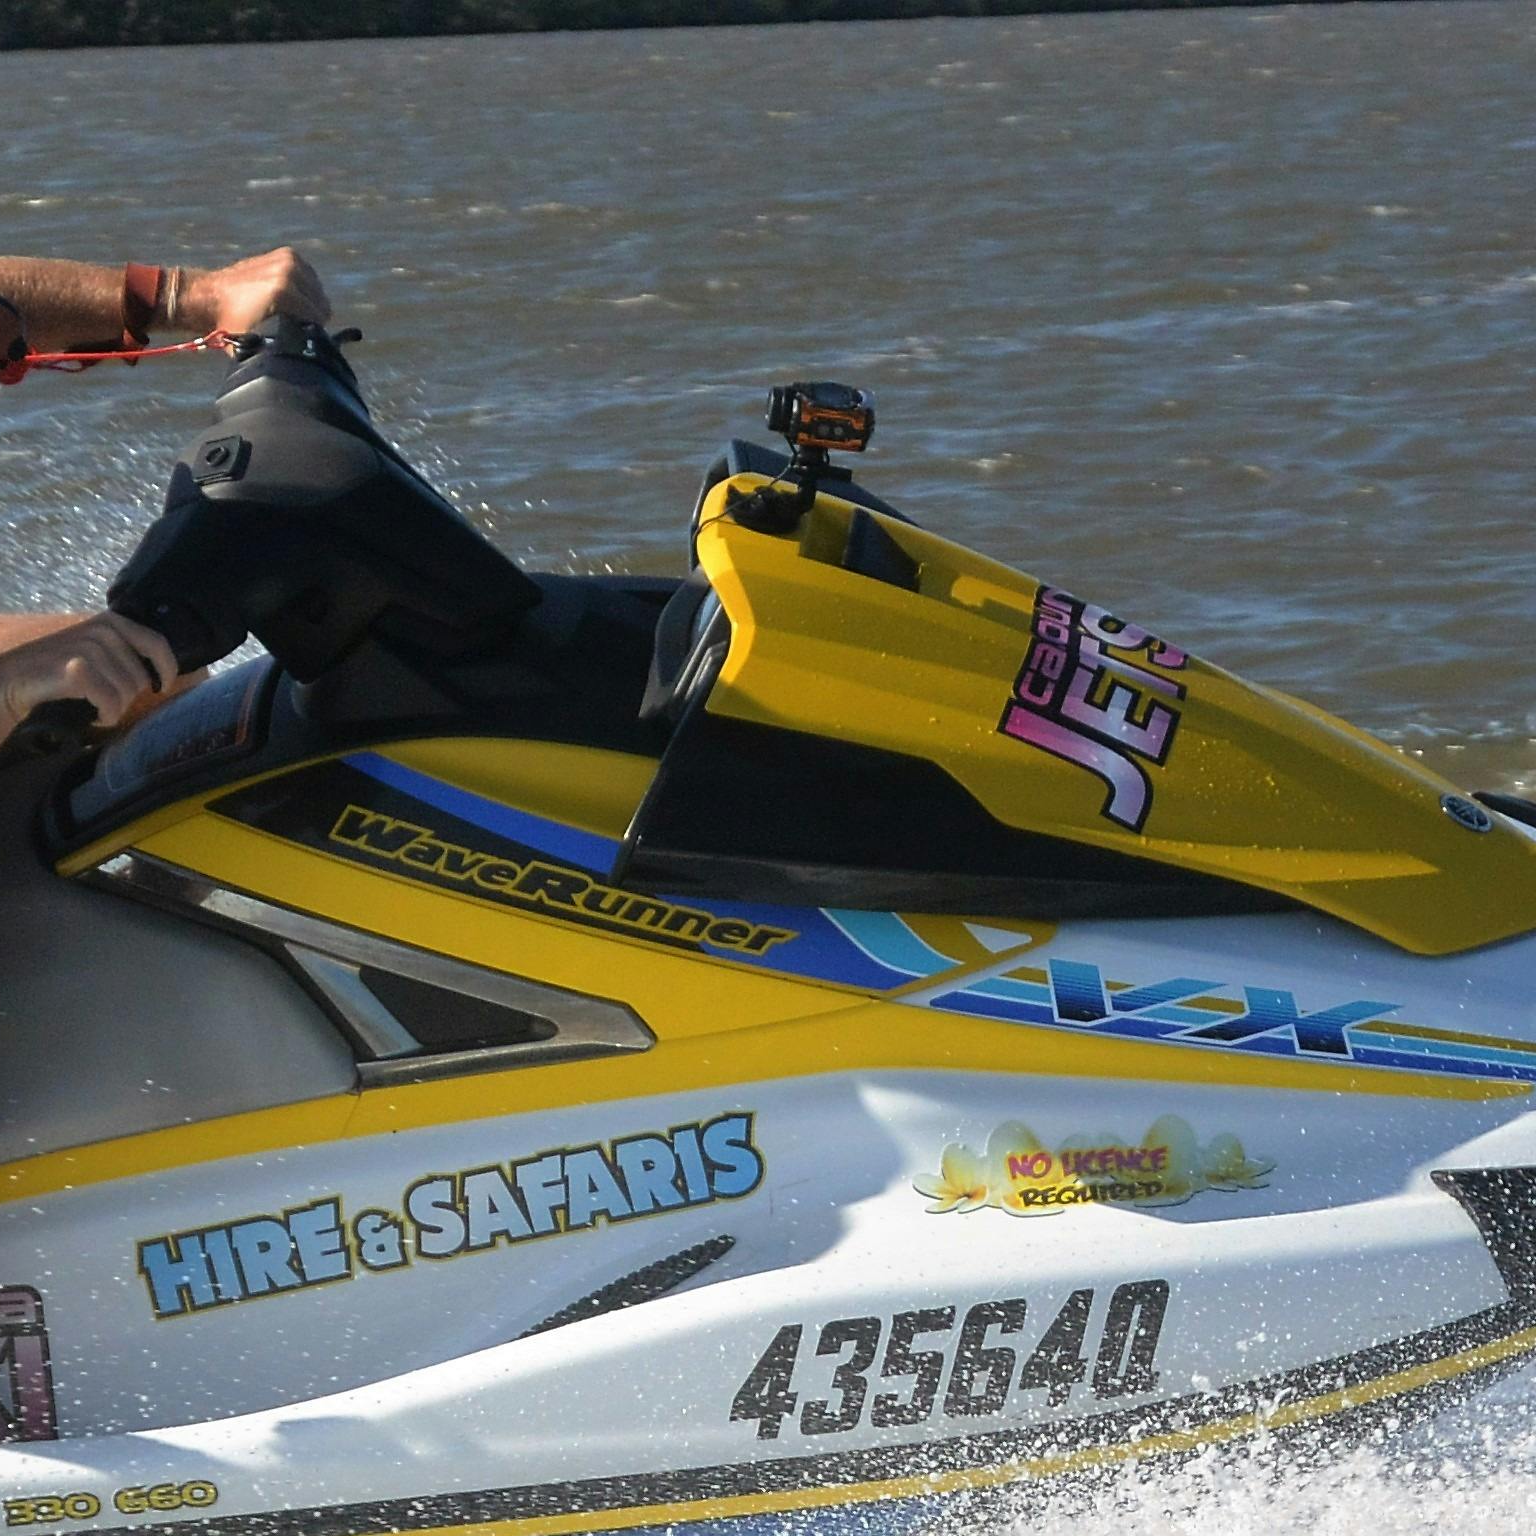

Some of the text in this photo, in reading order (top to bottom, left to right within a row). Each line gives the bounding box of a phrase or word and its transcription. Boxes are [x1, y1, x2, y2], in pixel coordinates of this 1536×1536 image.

[997, 603, 1188, 834] JETS
[328, 804, 798, 955] WaveRunner
[1048, 957, 1406, 1060] VX
[138, 1111, 764, 1320] HIRE & SAFARIS
[1007, 1145, 1168, 1180] NO LICENCE
[1019, 1180, 1163, 1207] REQUIRED
[729, 1279, 1169, 1440] 435640
[2, 1492, 101, 1527] 330
[114, 1479, 218, 1514] 660
